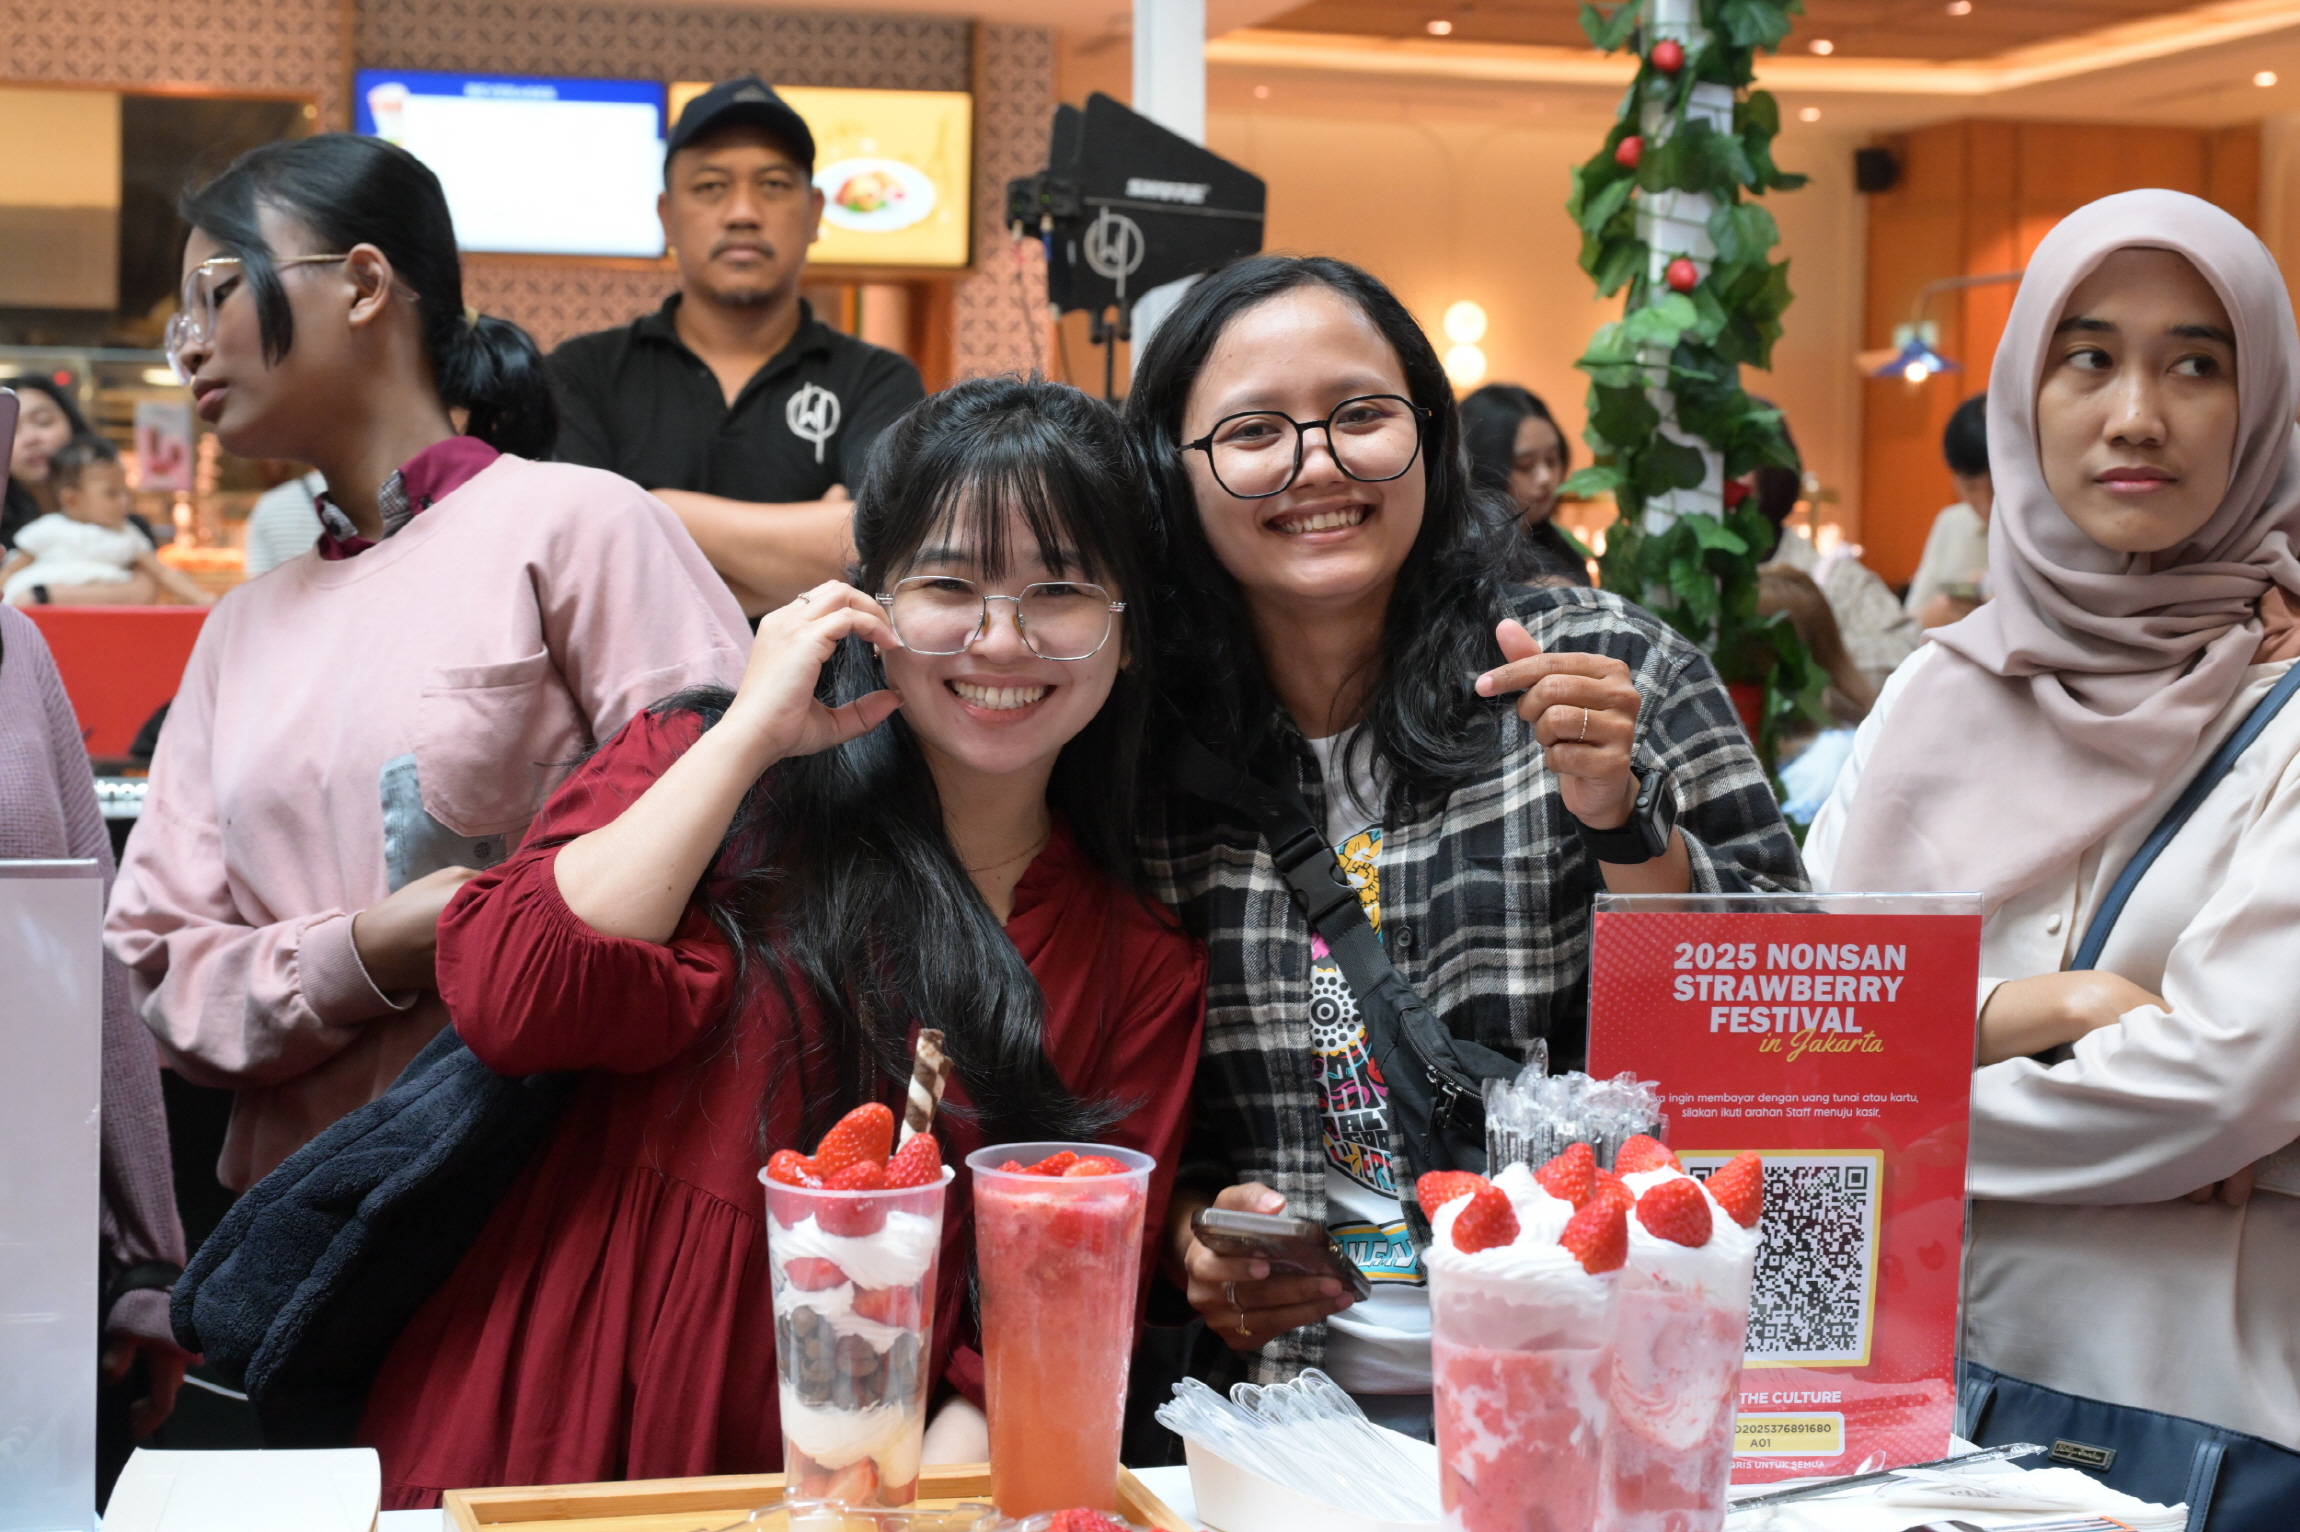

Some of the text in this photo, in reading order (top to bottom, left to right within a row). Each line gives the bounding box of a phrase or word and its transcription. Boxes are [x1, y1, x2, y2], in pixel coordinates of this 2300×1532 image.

[1673, 942, 1907, 971] 2025 NONSAN
[1672, 974, 1904, 1002] STRAWBERRY
[1709, 1006, 1863, 1033] FESTIVAL
[1758, 1028, 1884, 1063] in Jakarta
[1668, 1093, 1695, 1105] ingin
[1697, 1093, 1755, 1105] membayar
[1757, 1093, 1799, 1105] dengan
[1802, 1094, 1830, 1105] uang
[1832, 1092, 1860, 1102] tunai
[1862, 1093, 1888, 1102] atau
[1890, 1092, 1919, 1103] kartu,
[1681, 1107, 1881, 1119] silakan ikuti arahan Staff menuju kasir.
[1739, 1391, 1842, 1404] THE CULTURE
[1734, 1423, 1832, 1434] D2025376891680
[1749, 1438, 1771, 1448] A01
[1754, 1461, 1789, 1469] UNTUK
[1791, 1460, 1825, 1469] SEMUA
